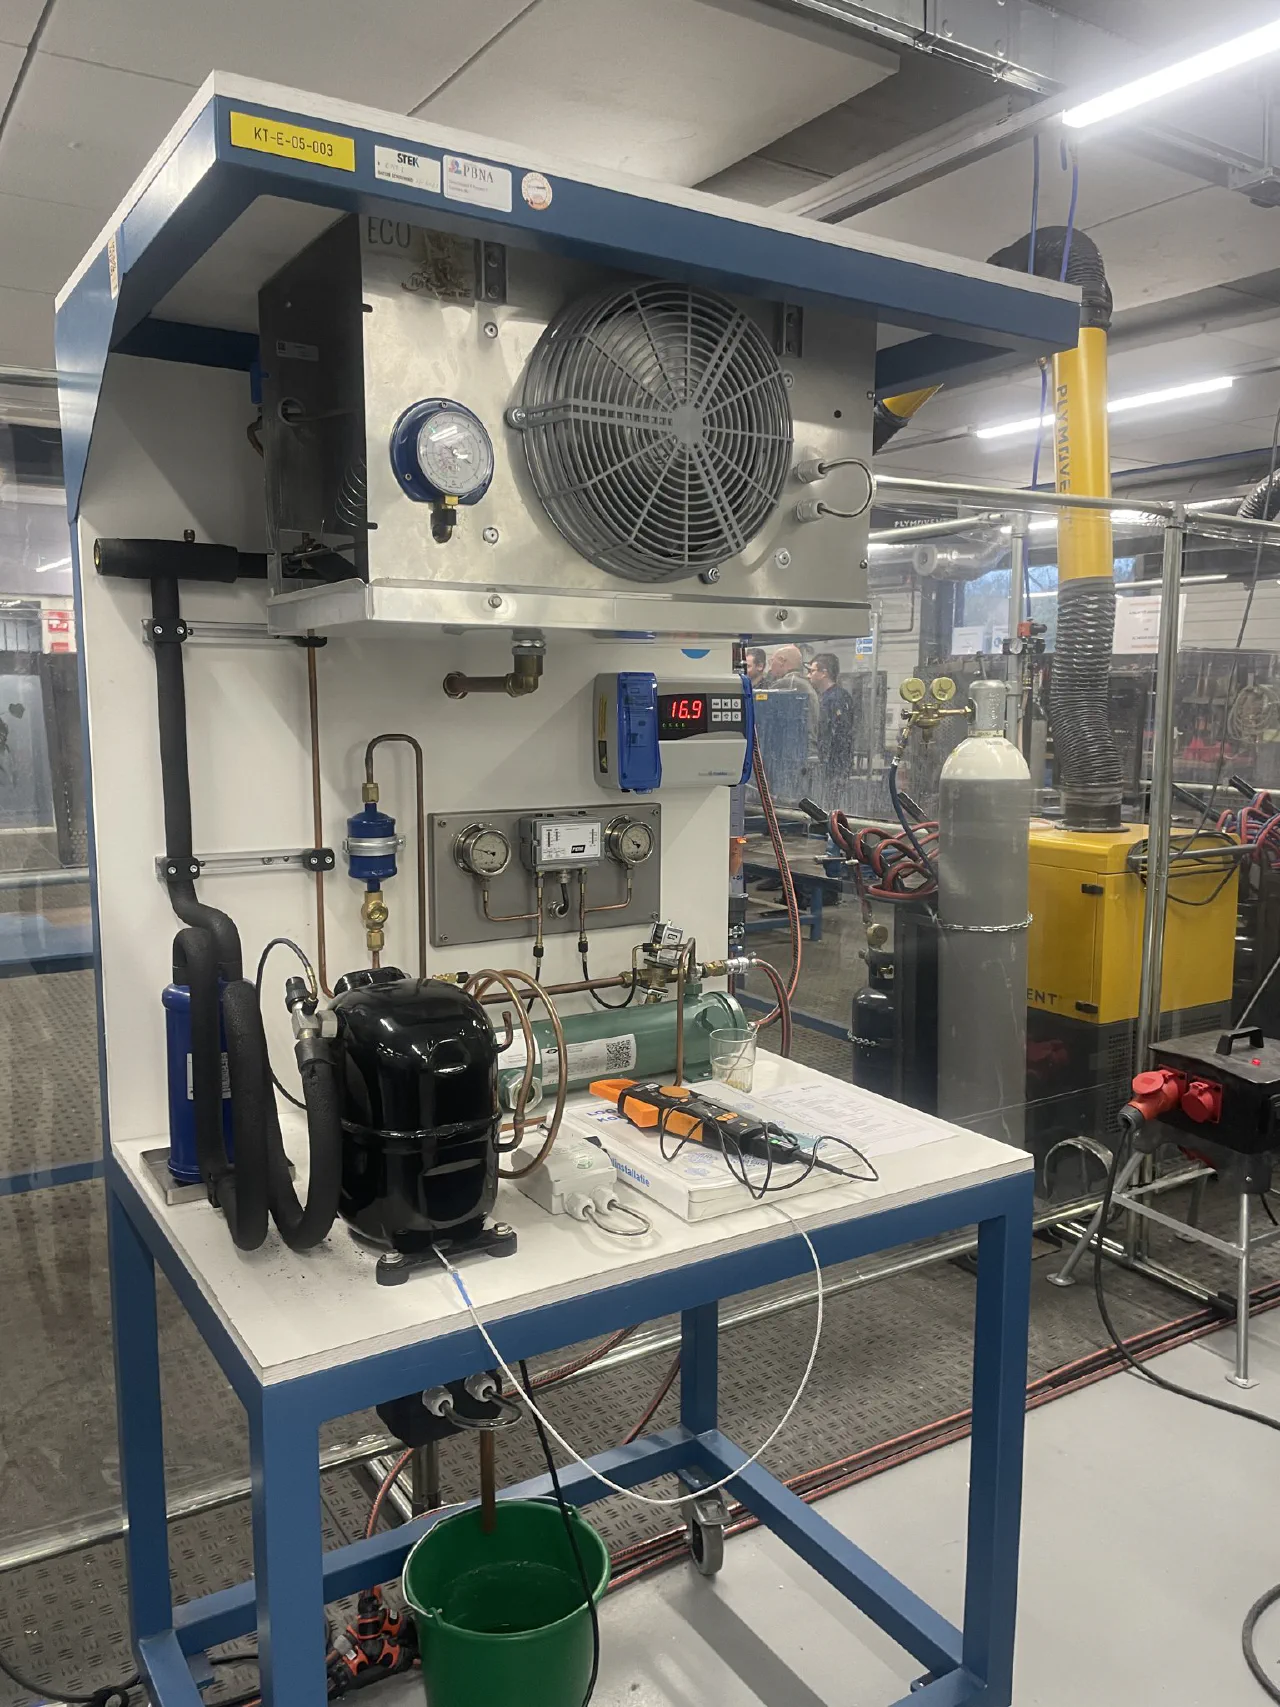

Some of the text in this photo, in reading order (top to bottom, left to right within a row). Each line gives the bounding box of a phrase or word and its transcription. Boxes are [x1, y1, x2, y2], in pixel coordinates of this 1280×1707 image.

[254, 127, 333, 157] KT-E-05-003
[397, 152, 420, 168] STEK
[463, 165, 494, 183] PBNA
[1056, 384, 1072, 524] PLYMOVE
[671, 699, 703, 719] 16.9
[1027, 987, 1058, 1005] ENT
[611, 1157, 650, 1188] linstallatie
